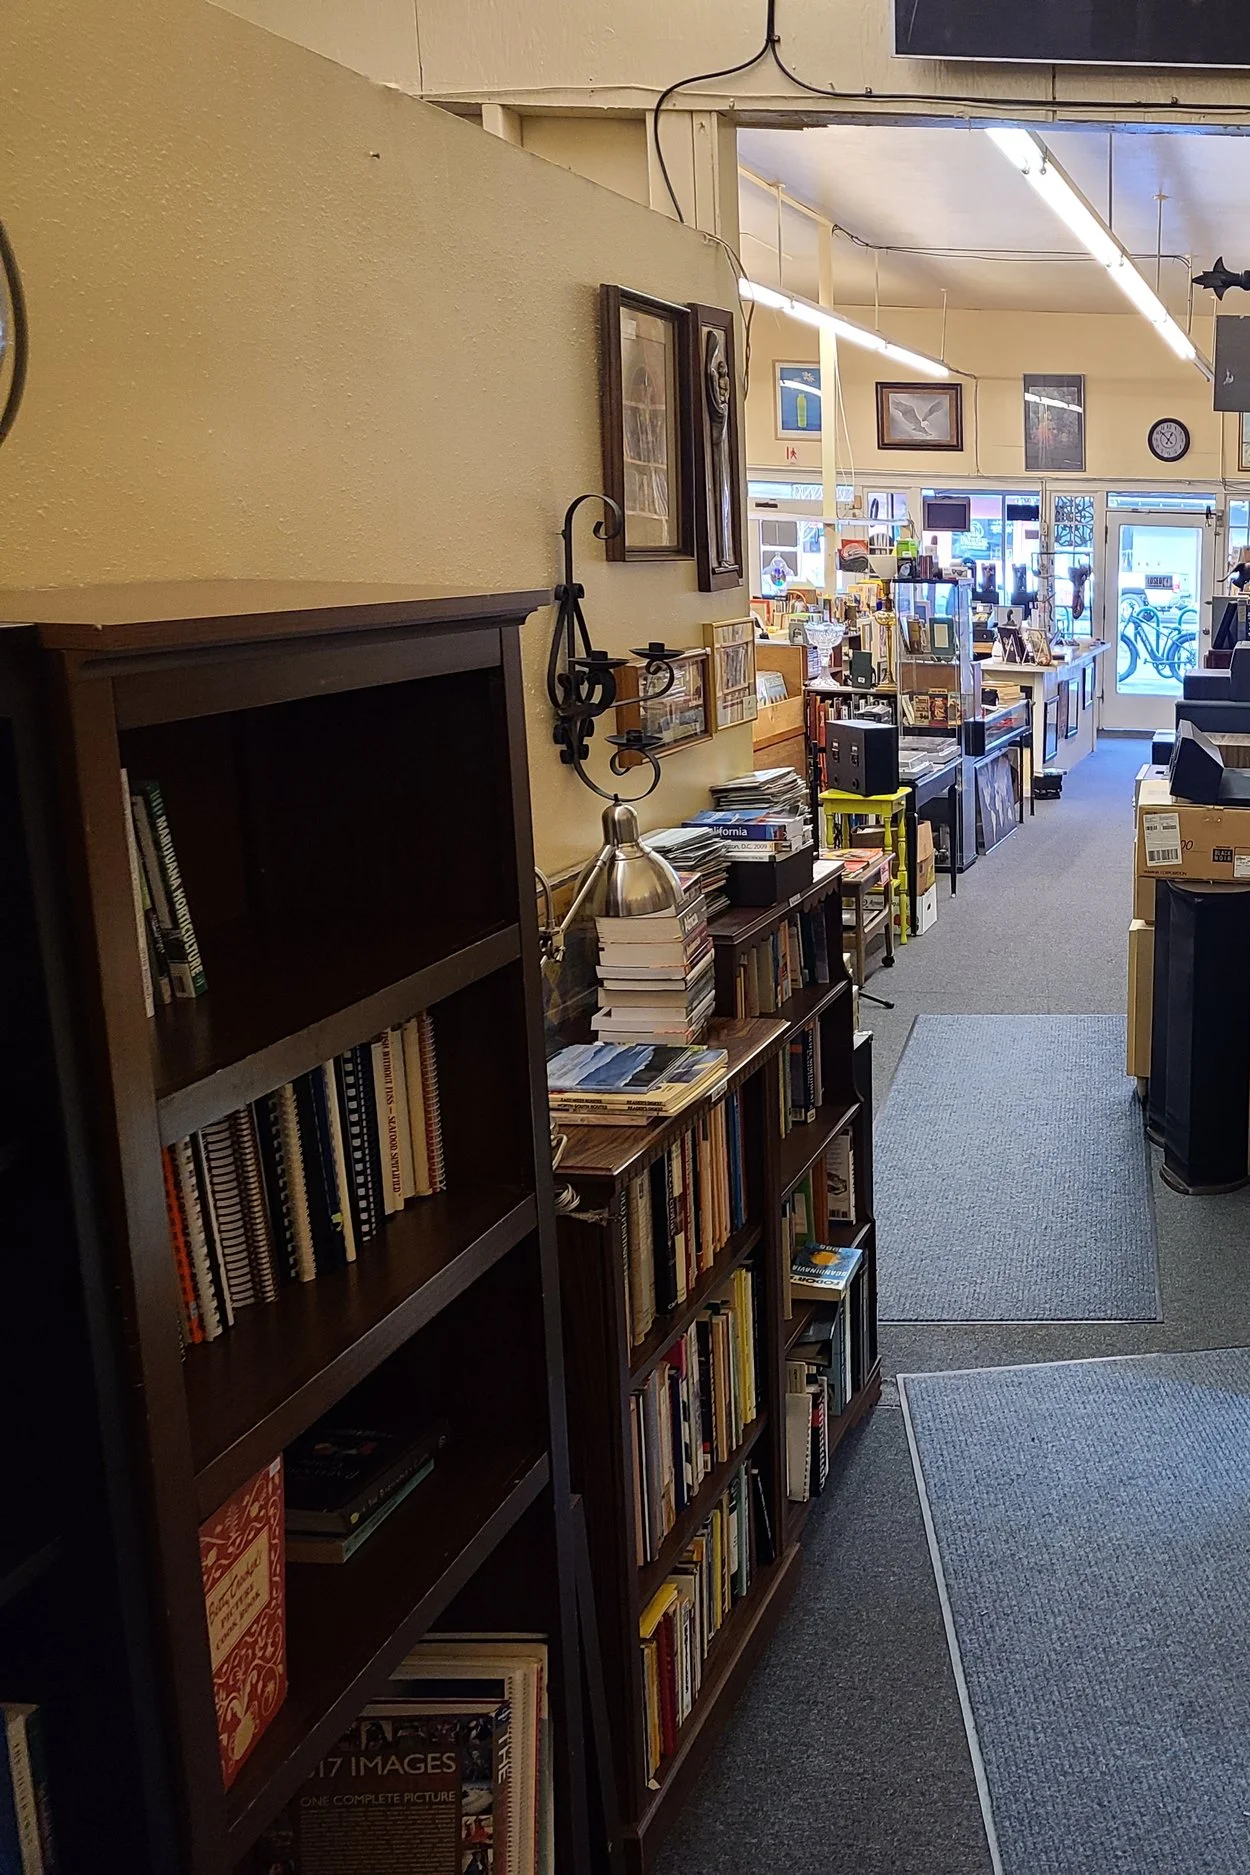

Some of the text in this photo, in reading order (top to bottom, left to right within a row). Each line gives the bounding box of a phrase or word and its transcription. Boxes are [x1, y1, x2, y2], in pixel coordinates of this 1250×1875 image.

[711, 825, 748, 837] lifornia
[741, 842, 752, 850] D.C.
[753, 842, 768, 850] 2009
[155, 814, 205, 975] MARIJUANA HORTICULTURE
[382, 1050, 392, 1082] WITHOUT
[385, 1085, 393, 1103] FUSS
[387, 1113, 397, 1148] SEAFOOD
[390, 1149, 400, 1189] SIMPLIFIED
[791, 1265, 850, 1277] SCANDINAVIA
[351, 1752, 456, 1776] IMAGES
[300, 1790, 456, 1808] ONE COMPLETE PICTURE
